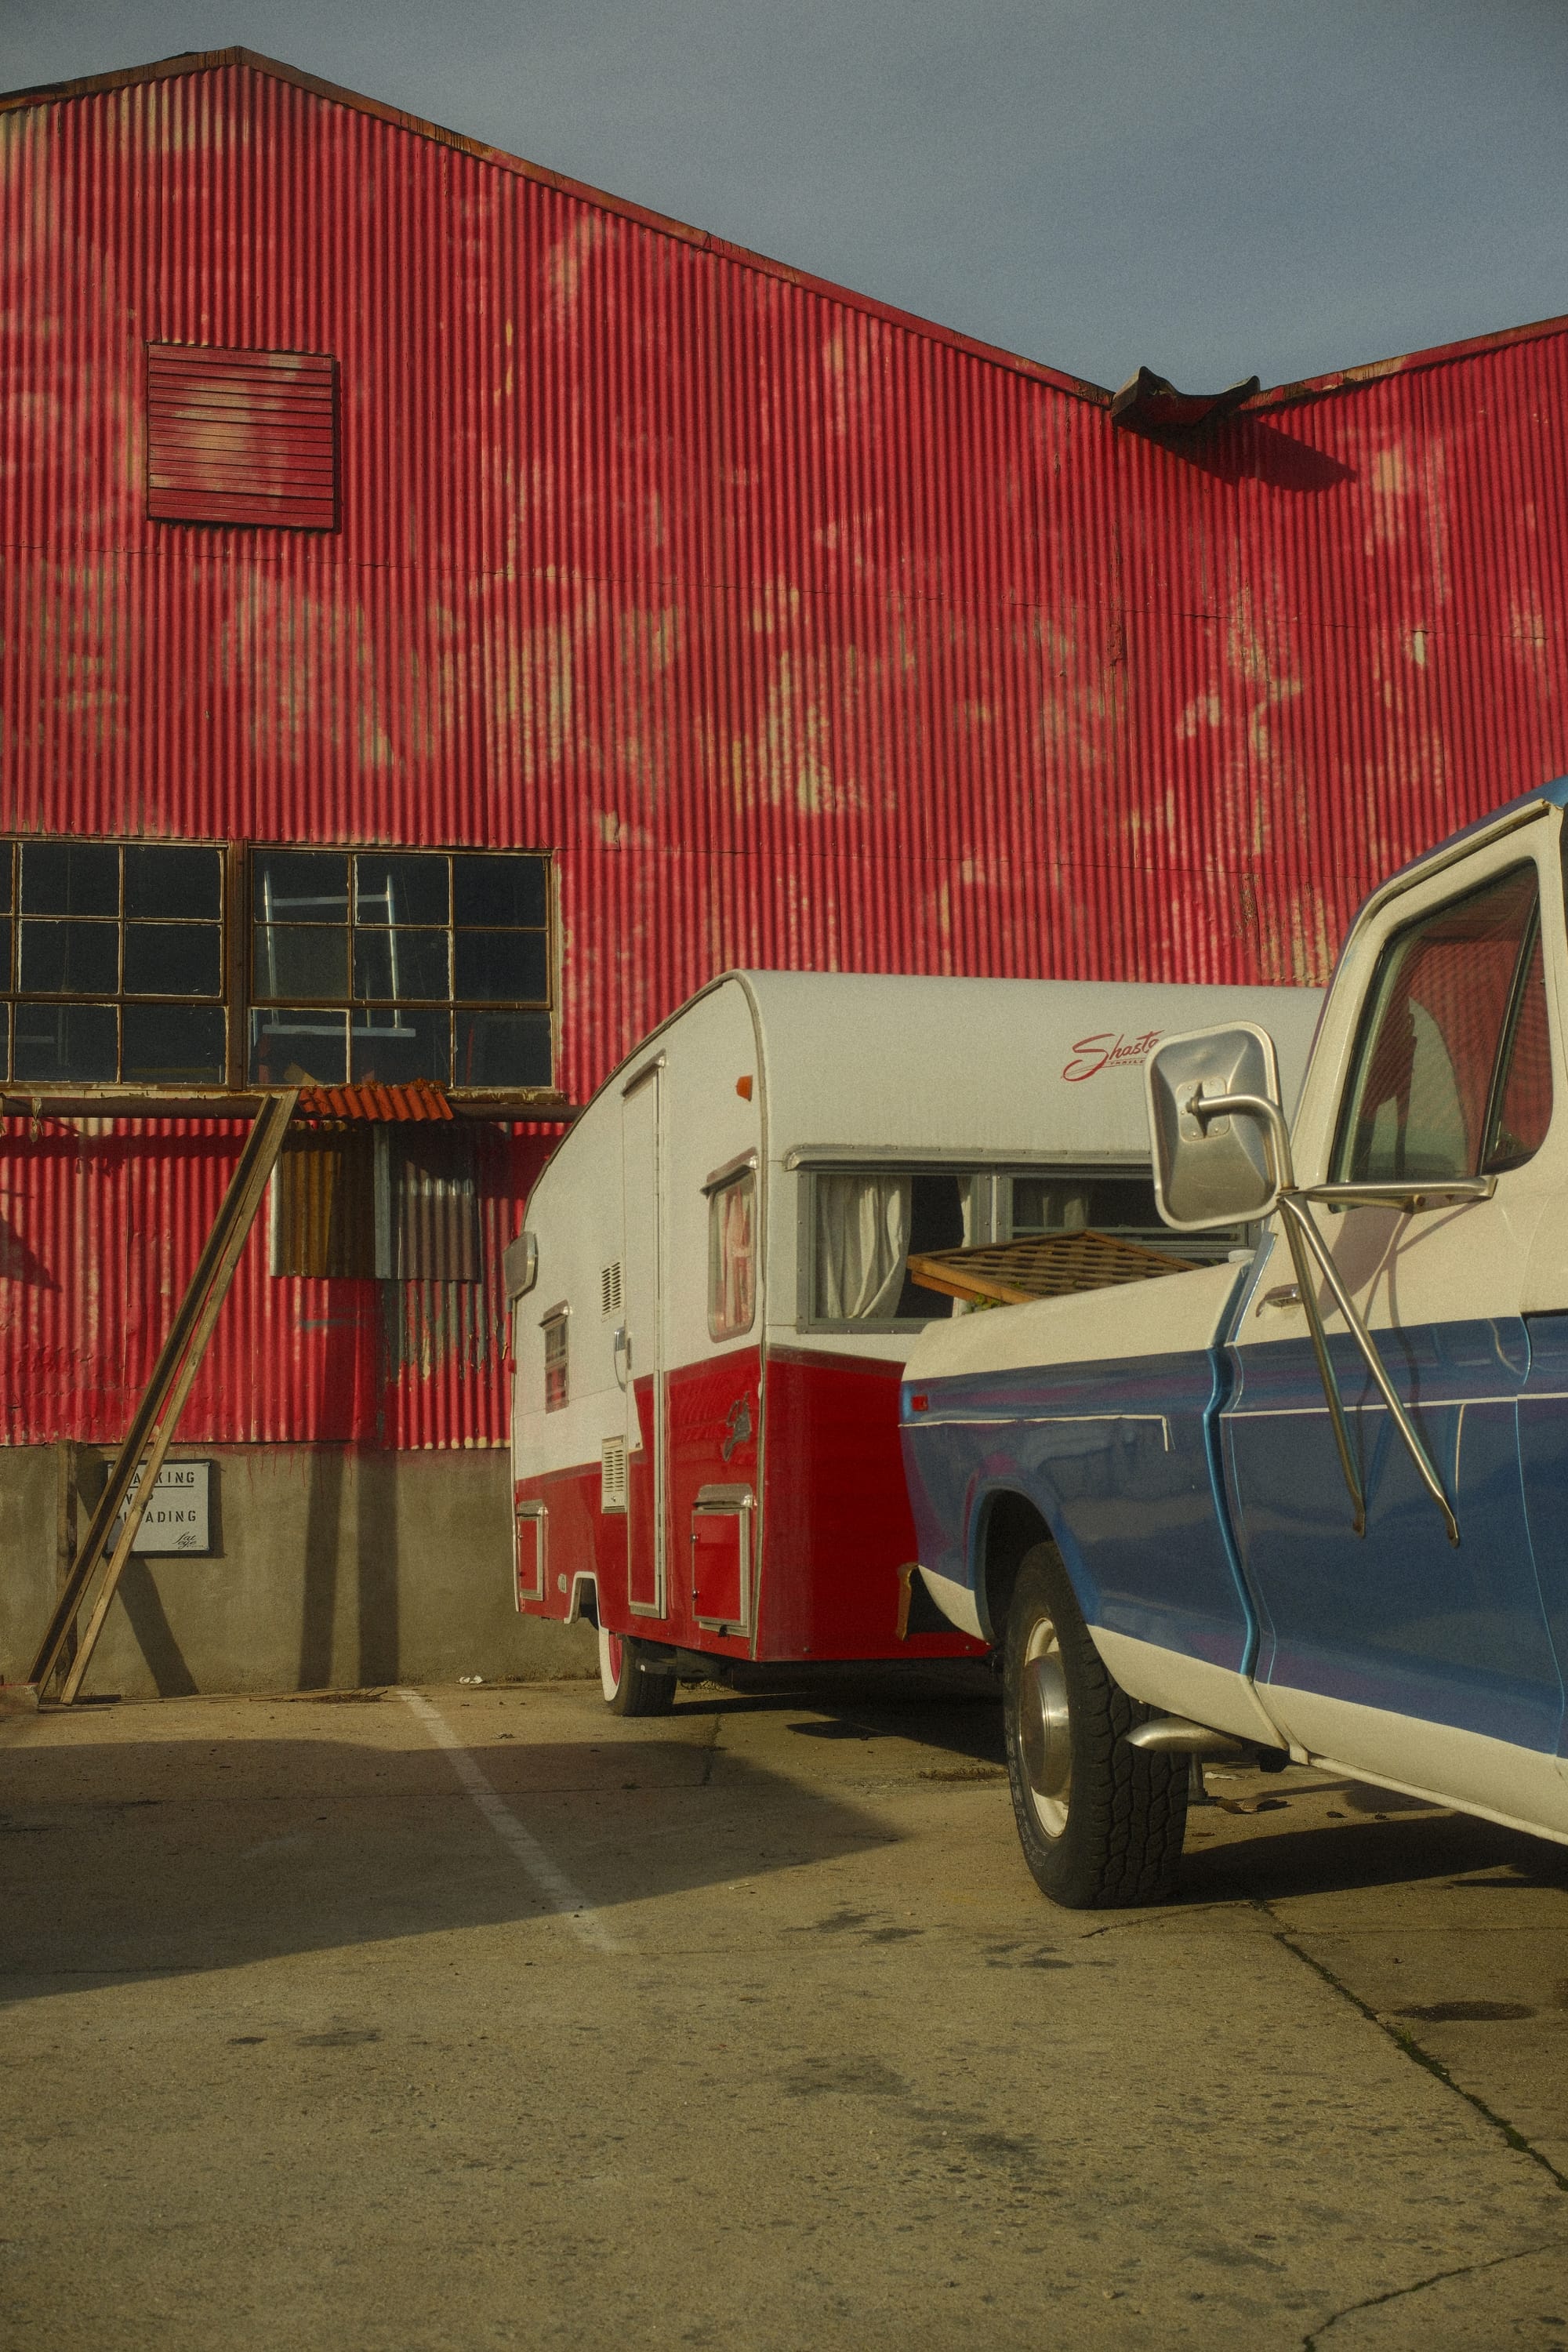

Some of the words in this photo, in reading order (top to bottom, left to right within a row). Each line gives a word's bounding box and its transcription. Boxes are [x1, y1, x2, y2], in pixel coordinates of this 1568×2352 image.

[1062, 1029, 1165, 1082] Shasta
[133, 1472, 194, 1483] AKING
[124, 1510, 196, 1523] LADING
